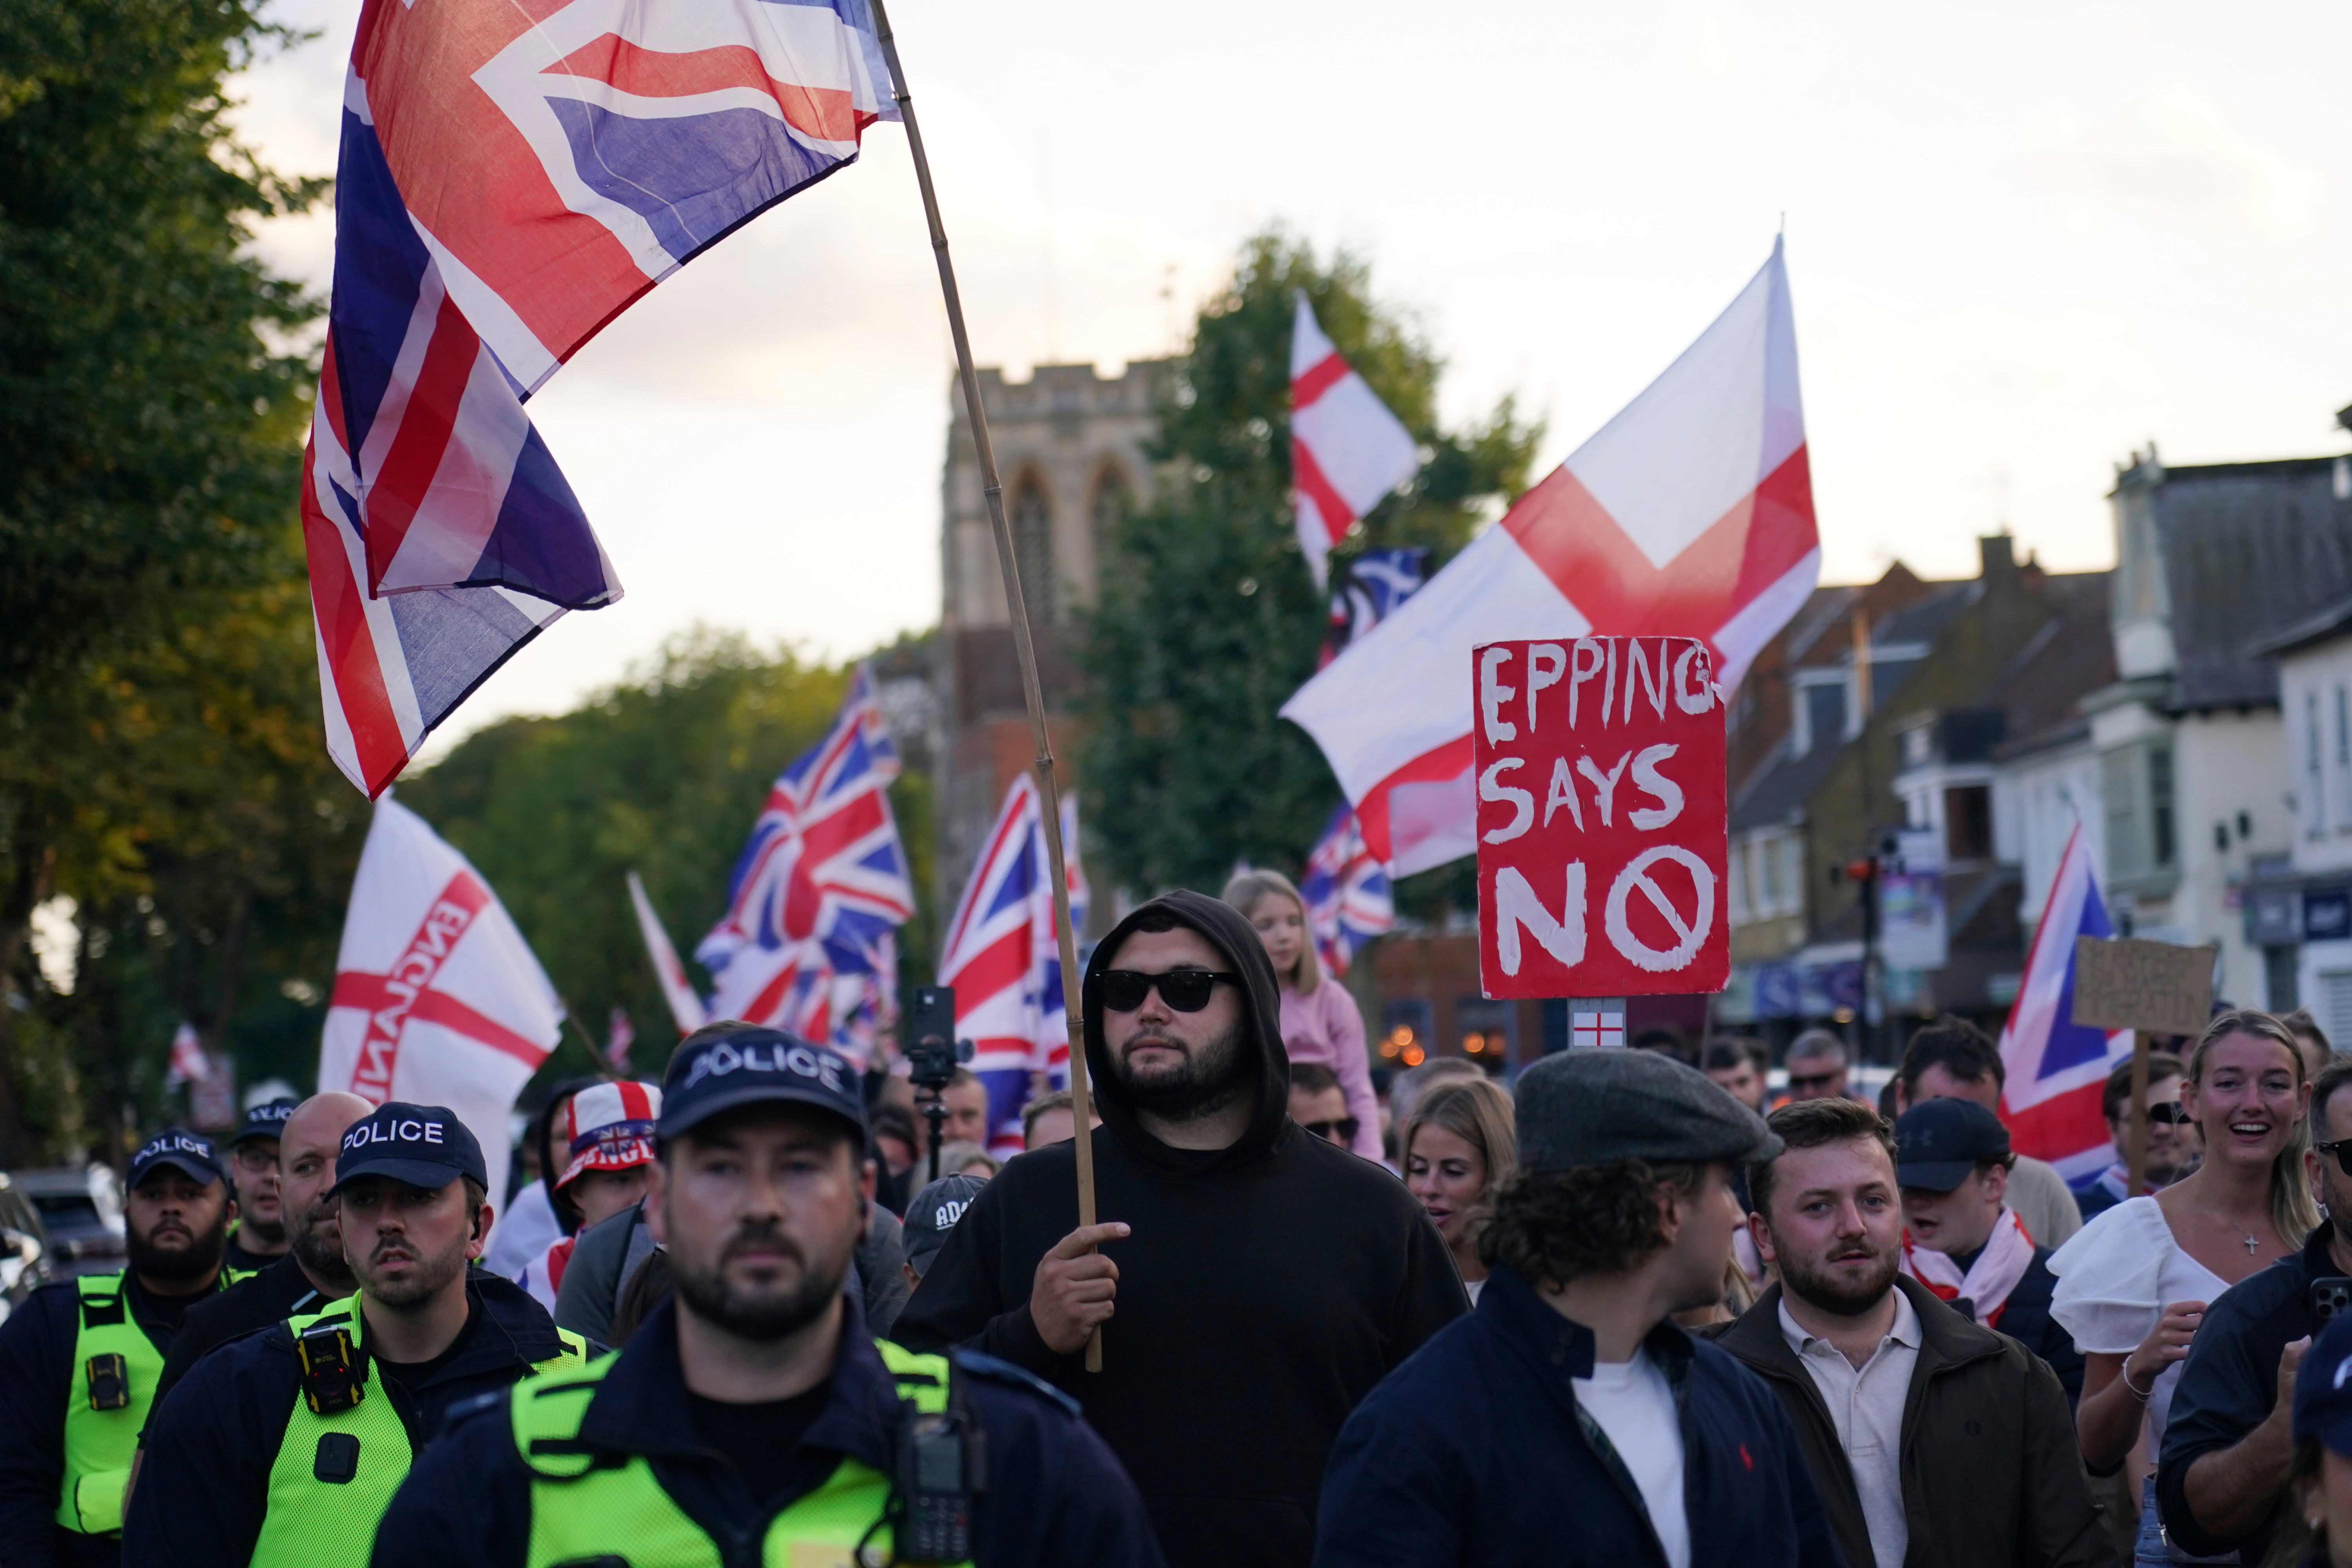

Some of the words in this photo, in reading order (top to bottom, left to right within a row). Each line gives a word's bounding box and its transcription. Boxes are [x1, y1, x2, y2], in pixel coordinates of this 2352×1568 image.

[1480, 638, 1715, 749] EPPING
[1479, 744, 1684, 844] SAYS
[1495, 845, 1715, 975] NO
[683, 1042, 844, 1094] POLICE
[134, 1136, 210, 1166] POLICE
[341, 1120, 443, 1157] POLICE
